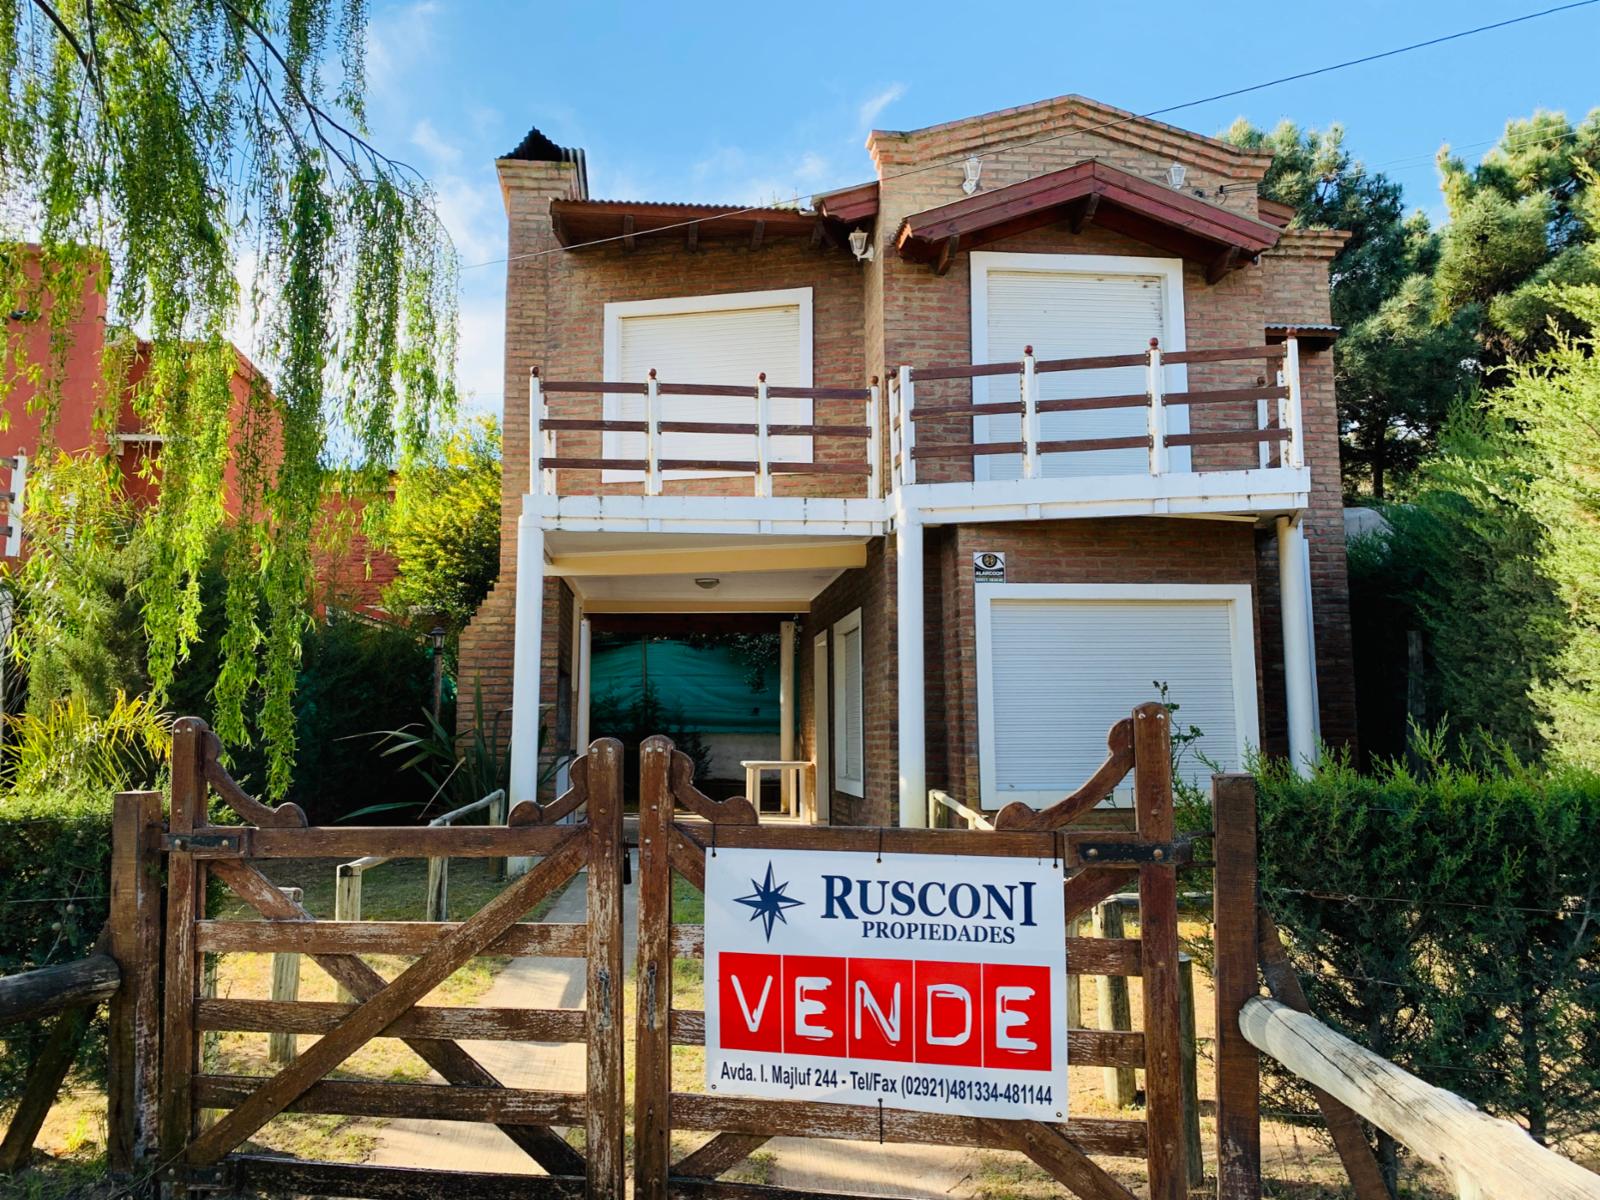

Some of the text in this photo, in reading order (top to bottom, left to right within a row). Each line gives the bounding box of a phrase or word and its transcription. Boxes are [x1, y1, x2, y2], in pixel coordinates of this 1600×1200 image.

[820, 875, 1038, 927] RUSCONI
[861, 921, 1016, 945] PROPIEDADES
[731, 974, 1039, 1054] VENDE
[720, 1061, 757, 1082] Avda.
[772, 1065, 812, 1090] Majluf
[815, 1068, 838, 1088] 244
[850, 1071, 898, 1093] Tel/Fax
[901, 1075, 1053, 1106] (02921)481334-481144
